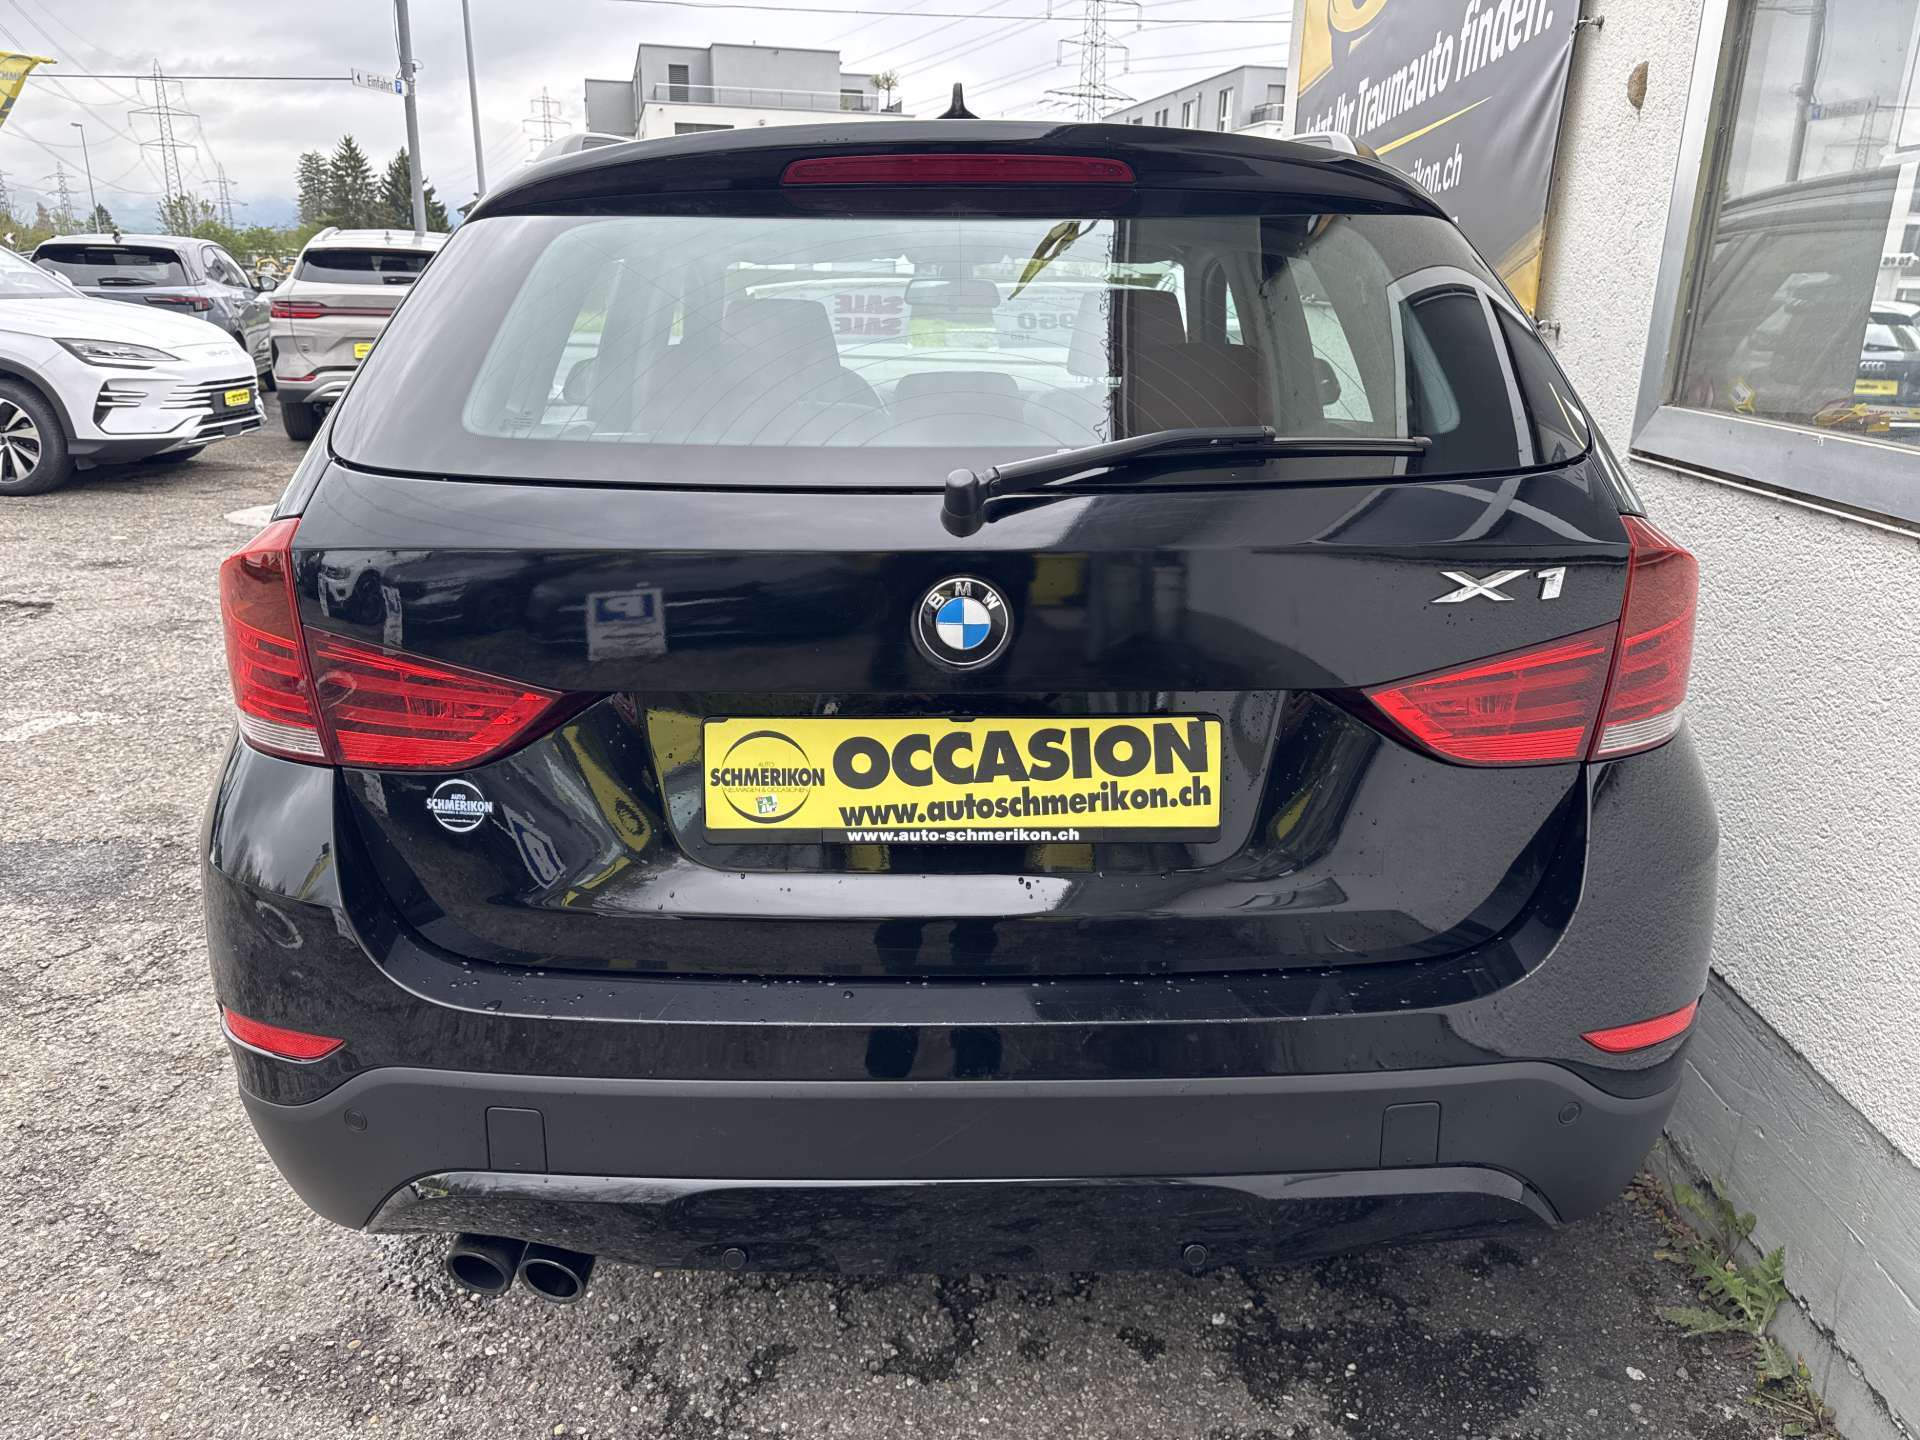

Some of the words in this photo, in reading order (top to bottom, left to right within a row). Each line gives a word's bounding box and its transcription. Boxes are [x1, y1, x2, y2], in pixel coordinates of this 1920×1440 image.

[1335, 92, 1356, 135] Ihr
[1355, 31, 1454, 138] Traumauto
[1455, 0, 1554, 83] finden.
[927, 581, 1001, 611] BMW
[1430, 567, 1567, 603] X1
[832, 721, 1208, 790] OCCASION
[710, 767, 826, 787] SCHMERIKON
[426, 797, 493, 813] SCHMERIKON
[450, 793, 467, 801] AUTO
[838, 775, 1212, 828] www.autoschmerikon.ch
[847, 828, 1080, 843] www.auto-schmerikon.ch
